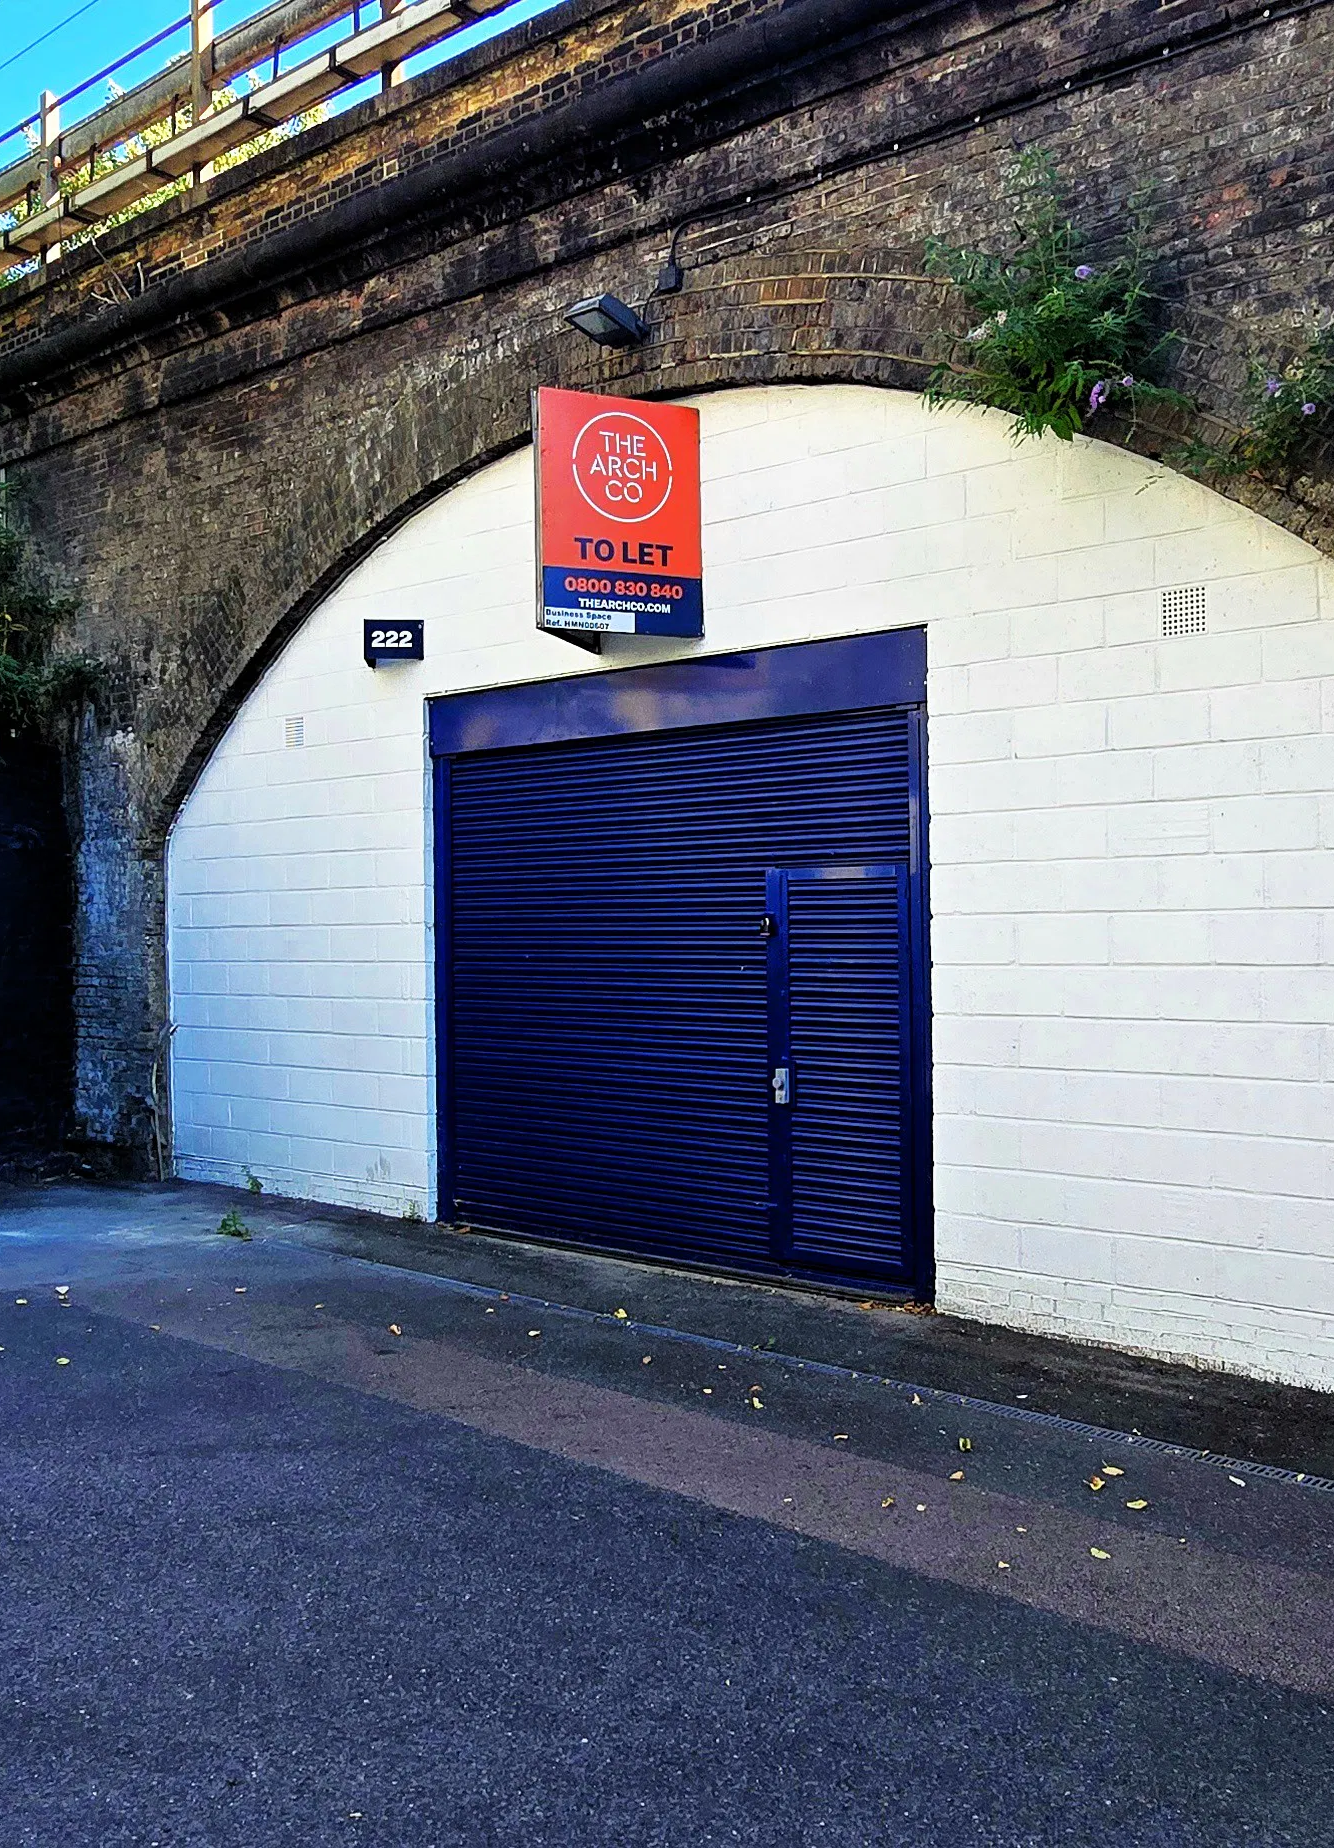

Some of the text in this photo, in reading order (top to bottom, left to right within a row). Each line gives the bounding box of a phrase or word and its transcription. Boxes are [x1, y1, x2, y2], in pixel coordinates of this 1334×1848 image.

[598, 431, 646, 457] THE
[590, 454, 657, 481] ARCH
[605, 480, 643, 503] CO
[574, 537, 674, 566] TO LET
[564, 576, 683, 599] 0800 830 840
[545, 608, 612, 620] Business Space
[578, 597, 671, 614] THEARCHCO.COM
[545, 618, 562, 627] Ref.
[371, 630, 413, 648] 222
